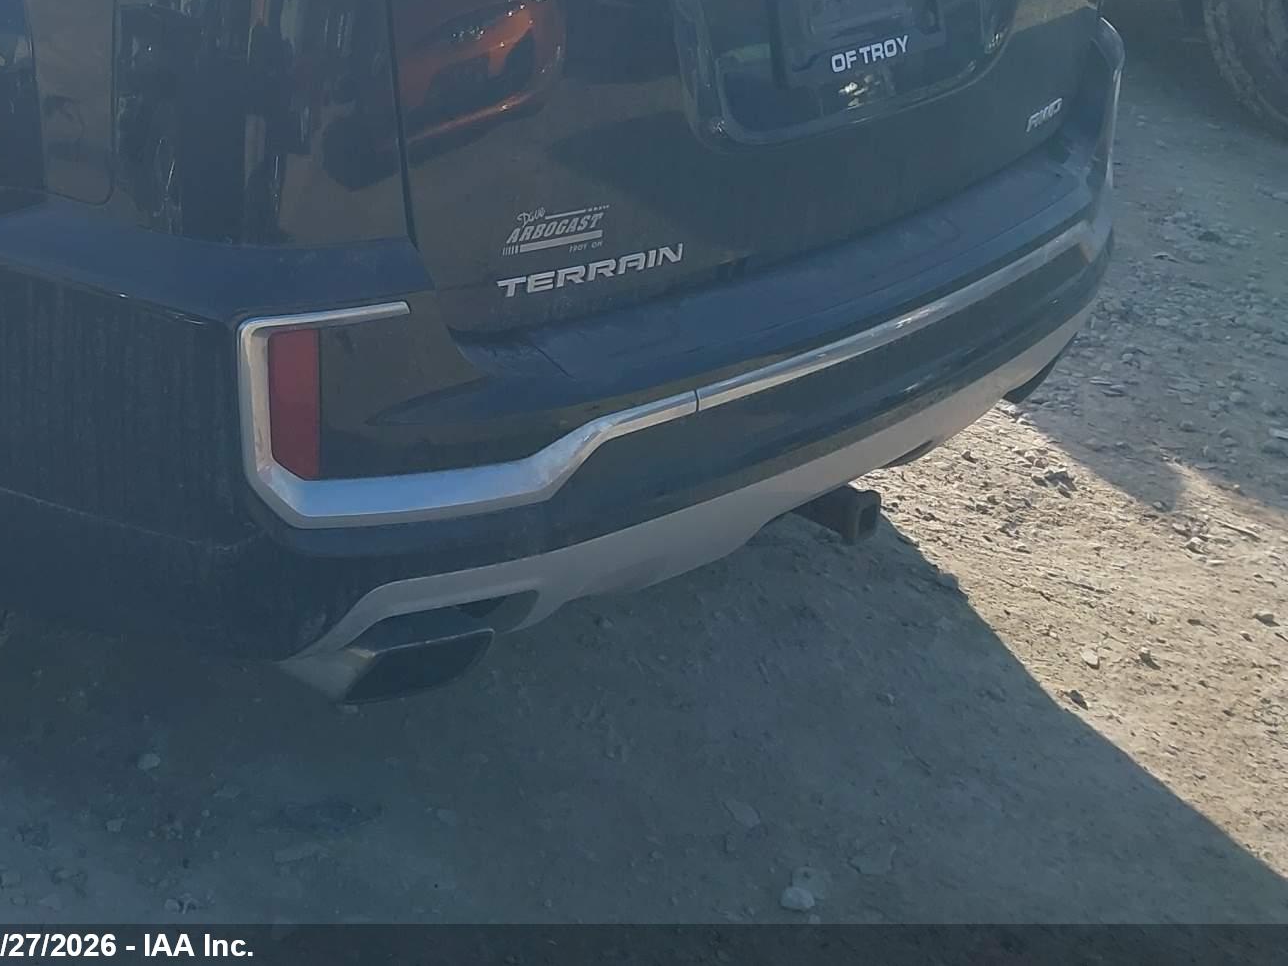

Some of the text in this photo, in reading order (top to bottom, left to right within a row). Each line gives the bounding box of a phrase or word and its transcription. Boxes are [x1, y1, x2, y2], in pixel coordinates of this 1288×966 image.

[831, 35, 909, 73] OF TROY
[505, 212, 604, 244] ARBOGAST
[496, 242, 684, 298] TERRAIN
